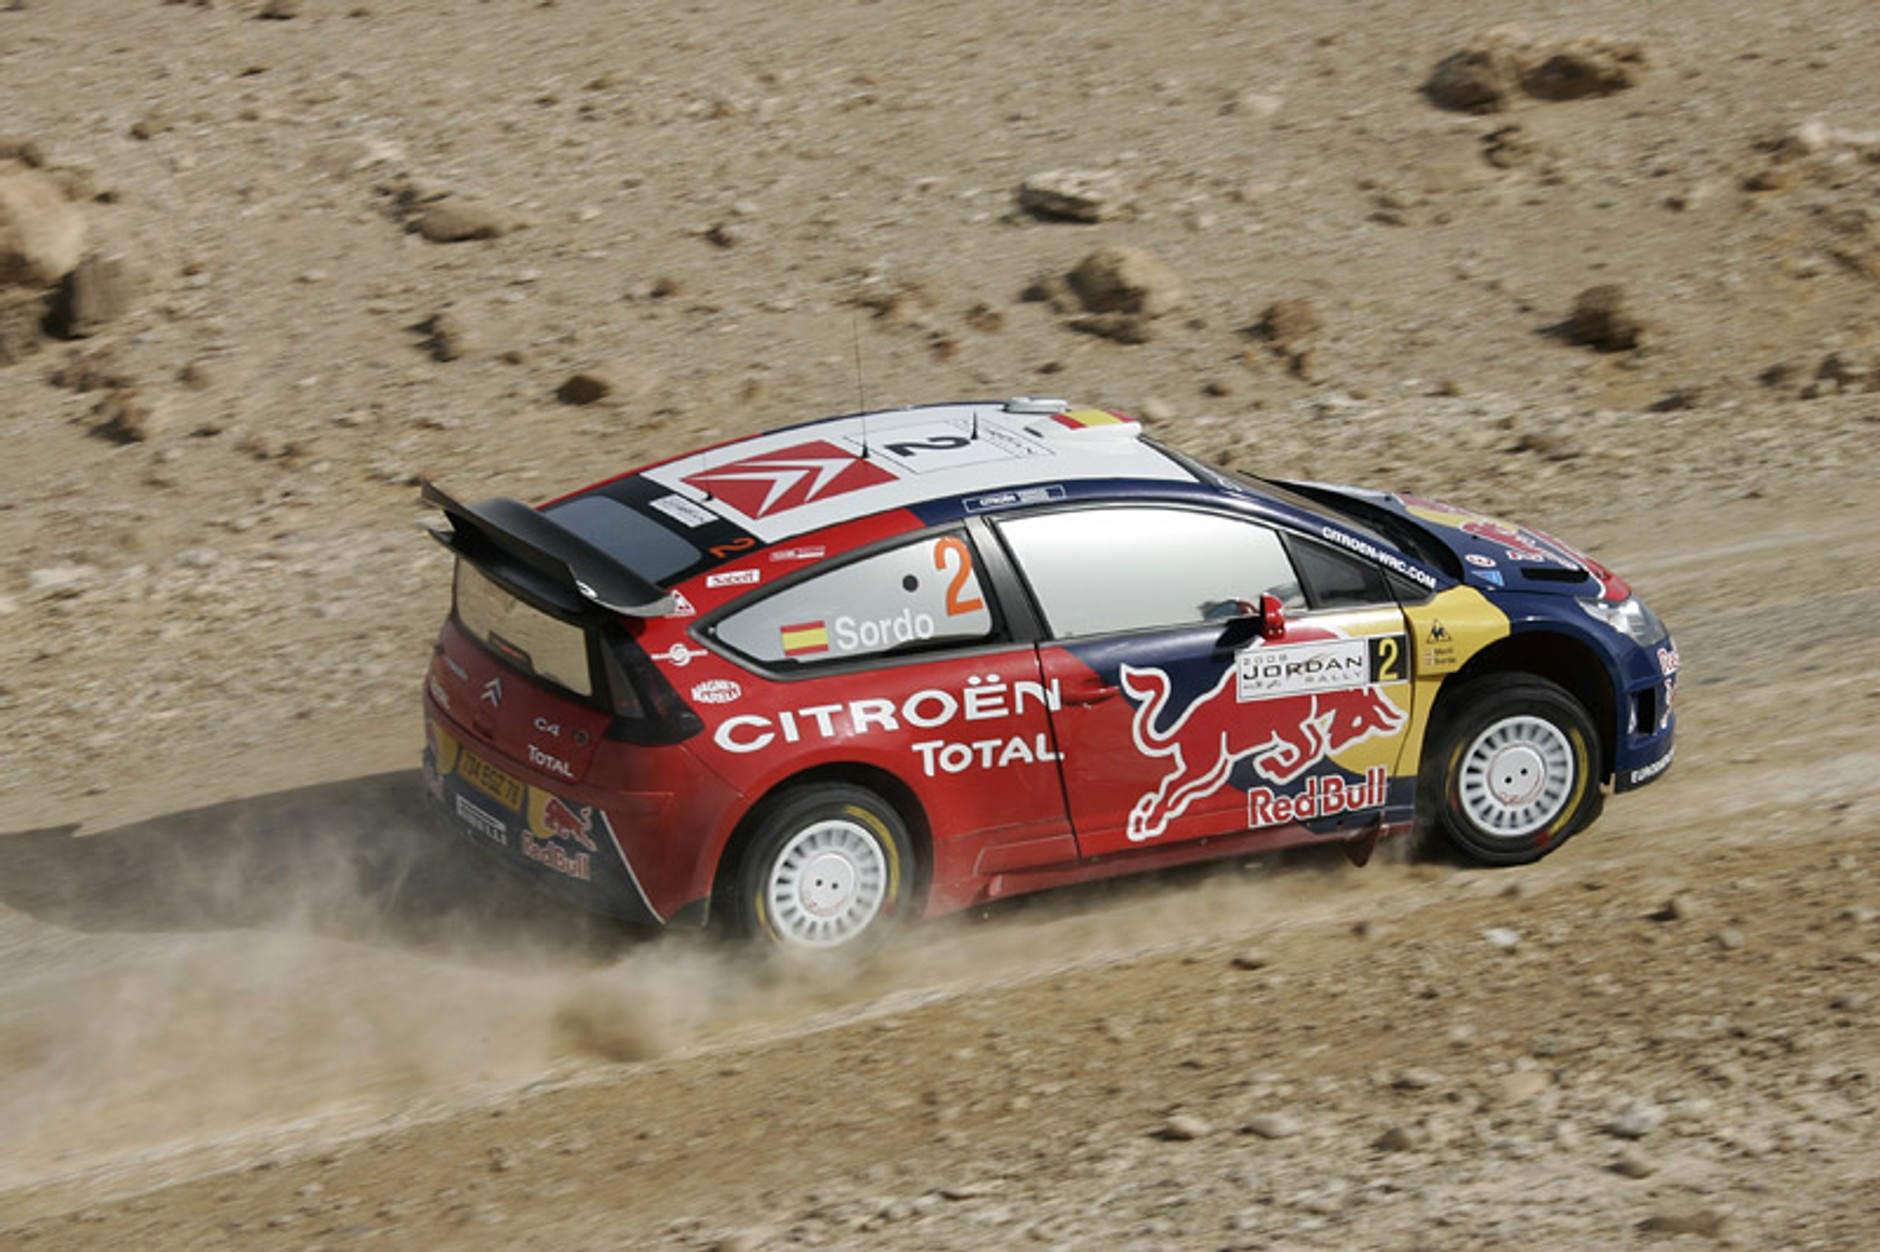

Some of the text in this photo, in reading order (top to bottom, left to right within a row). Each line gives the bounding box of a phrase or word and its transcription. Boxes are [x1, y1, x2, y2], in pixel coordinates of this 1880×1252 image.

[884, 436, 970, 457] 2
[709, 537, 755, 558] 2
[933, 535, 983, 616] 2
[835, 608, 934, 650] Sordo
[1243, 655, 1363, 681] JORDAN
[1378, 638, 1399, 681] 2
[533, 716, 560, 736] C4
[713, 673, 1063, 753] CITROËN
[527, 743, 574, 778] TOTAL
[911, 732, 1065, 777] TOTAL
